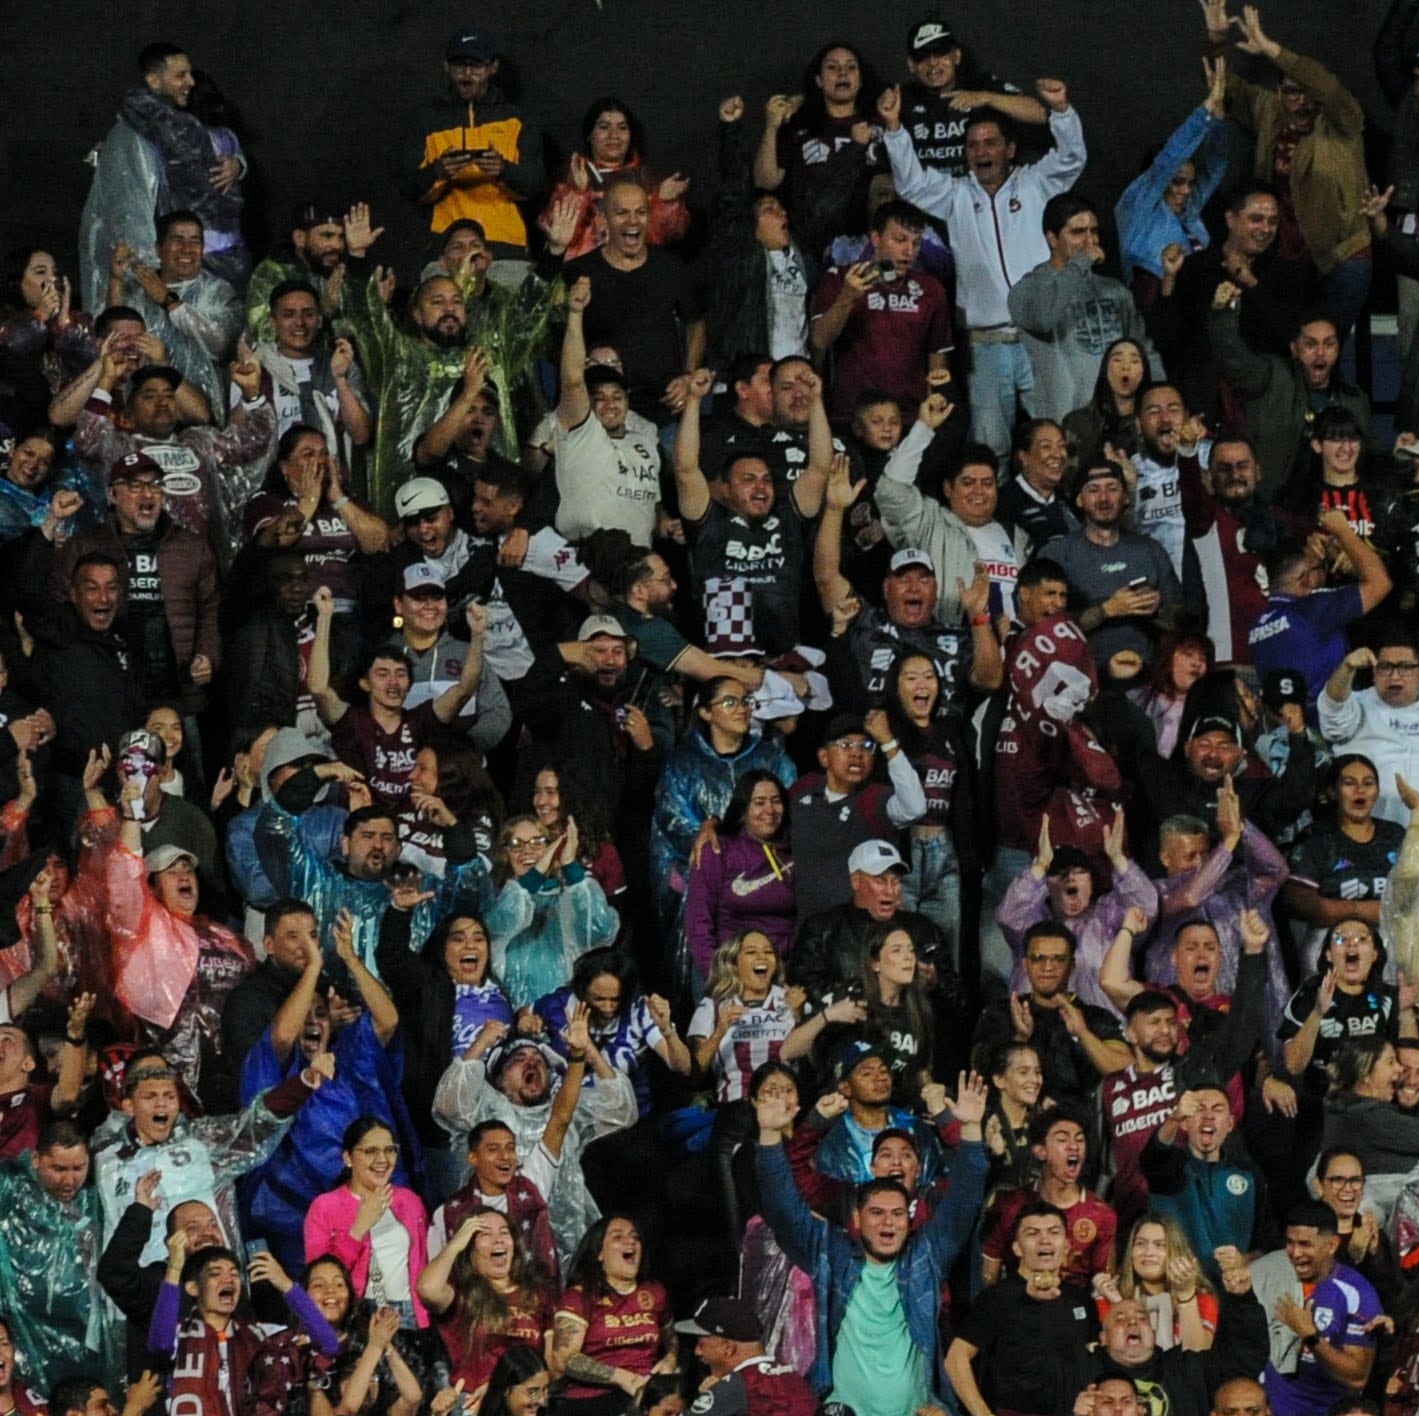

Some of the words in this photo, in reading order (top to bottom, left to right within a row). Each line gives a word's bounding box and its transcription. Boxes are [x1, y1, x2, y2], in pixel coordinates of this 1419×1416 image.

[889, 294, 919, 308] BAC
[124, 454, 139, 466] S
[1280, 679, 1293, 694] S
[1131, 1079, 1176, 1110] BAC
[1114, 1107, 1178, 1136] LIBERTY
[622, 1311, 655, 1327] BAC
